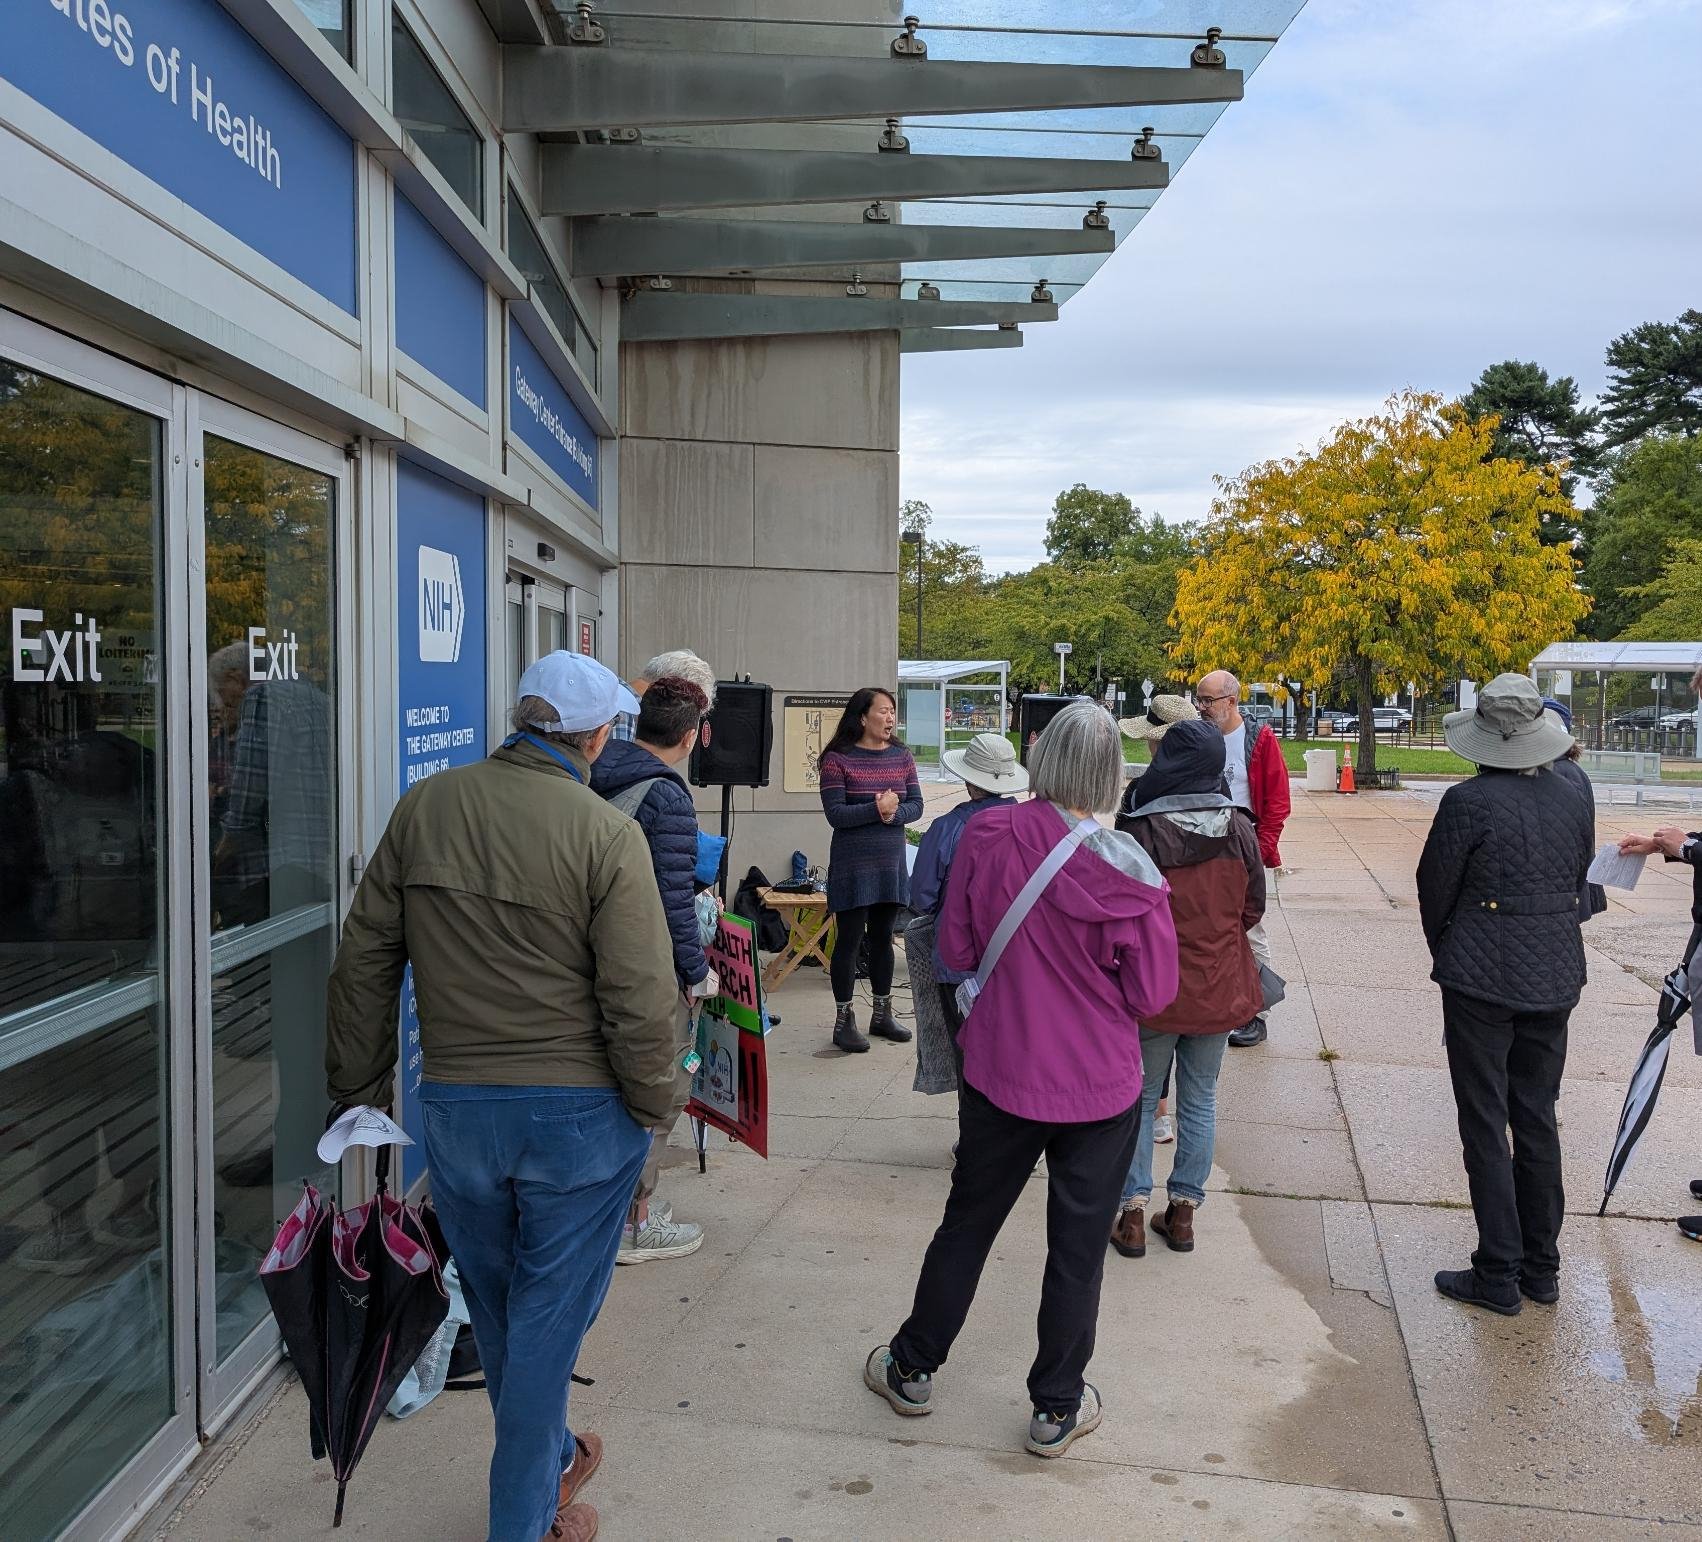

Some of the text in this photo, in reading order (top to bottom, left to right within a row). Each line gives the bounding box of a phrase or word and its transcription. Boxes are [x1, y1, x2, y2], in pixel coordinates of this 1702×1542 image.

[146, 43, 181, 105] of
[190, 62, 282, 190] Health
[515, 365, 540, 423] Gateway
[423, 577, 453, 634] NIH
[12, 607, 102, 682] Exit
[118, 635, 136, 647] NO
[248, 626, 299, 681] Exit
[406, 705, 450, 727] WELCOME TO
[406, 727, 475, 756] THE GATEWAY CENTER
